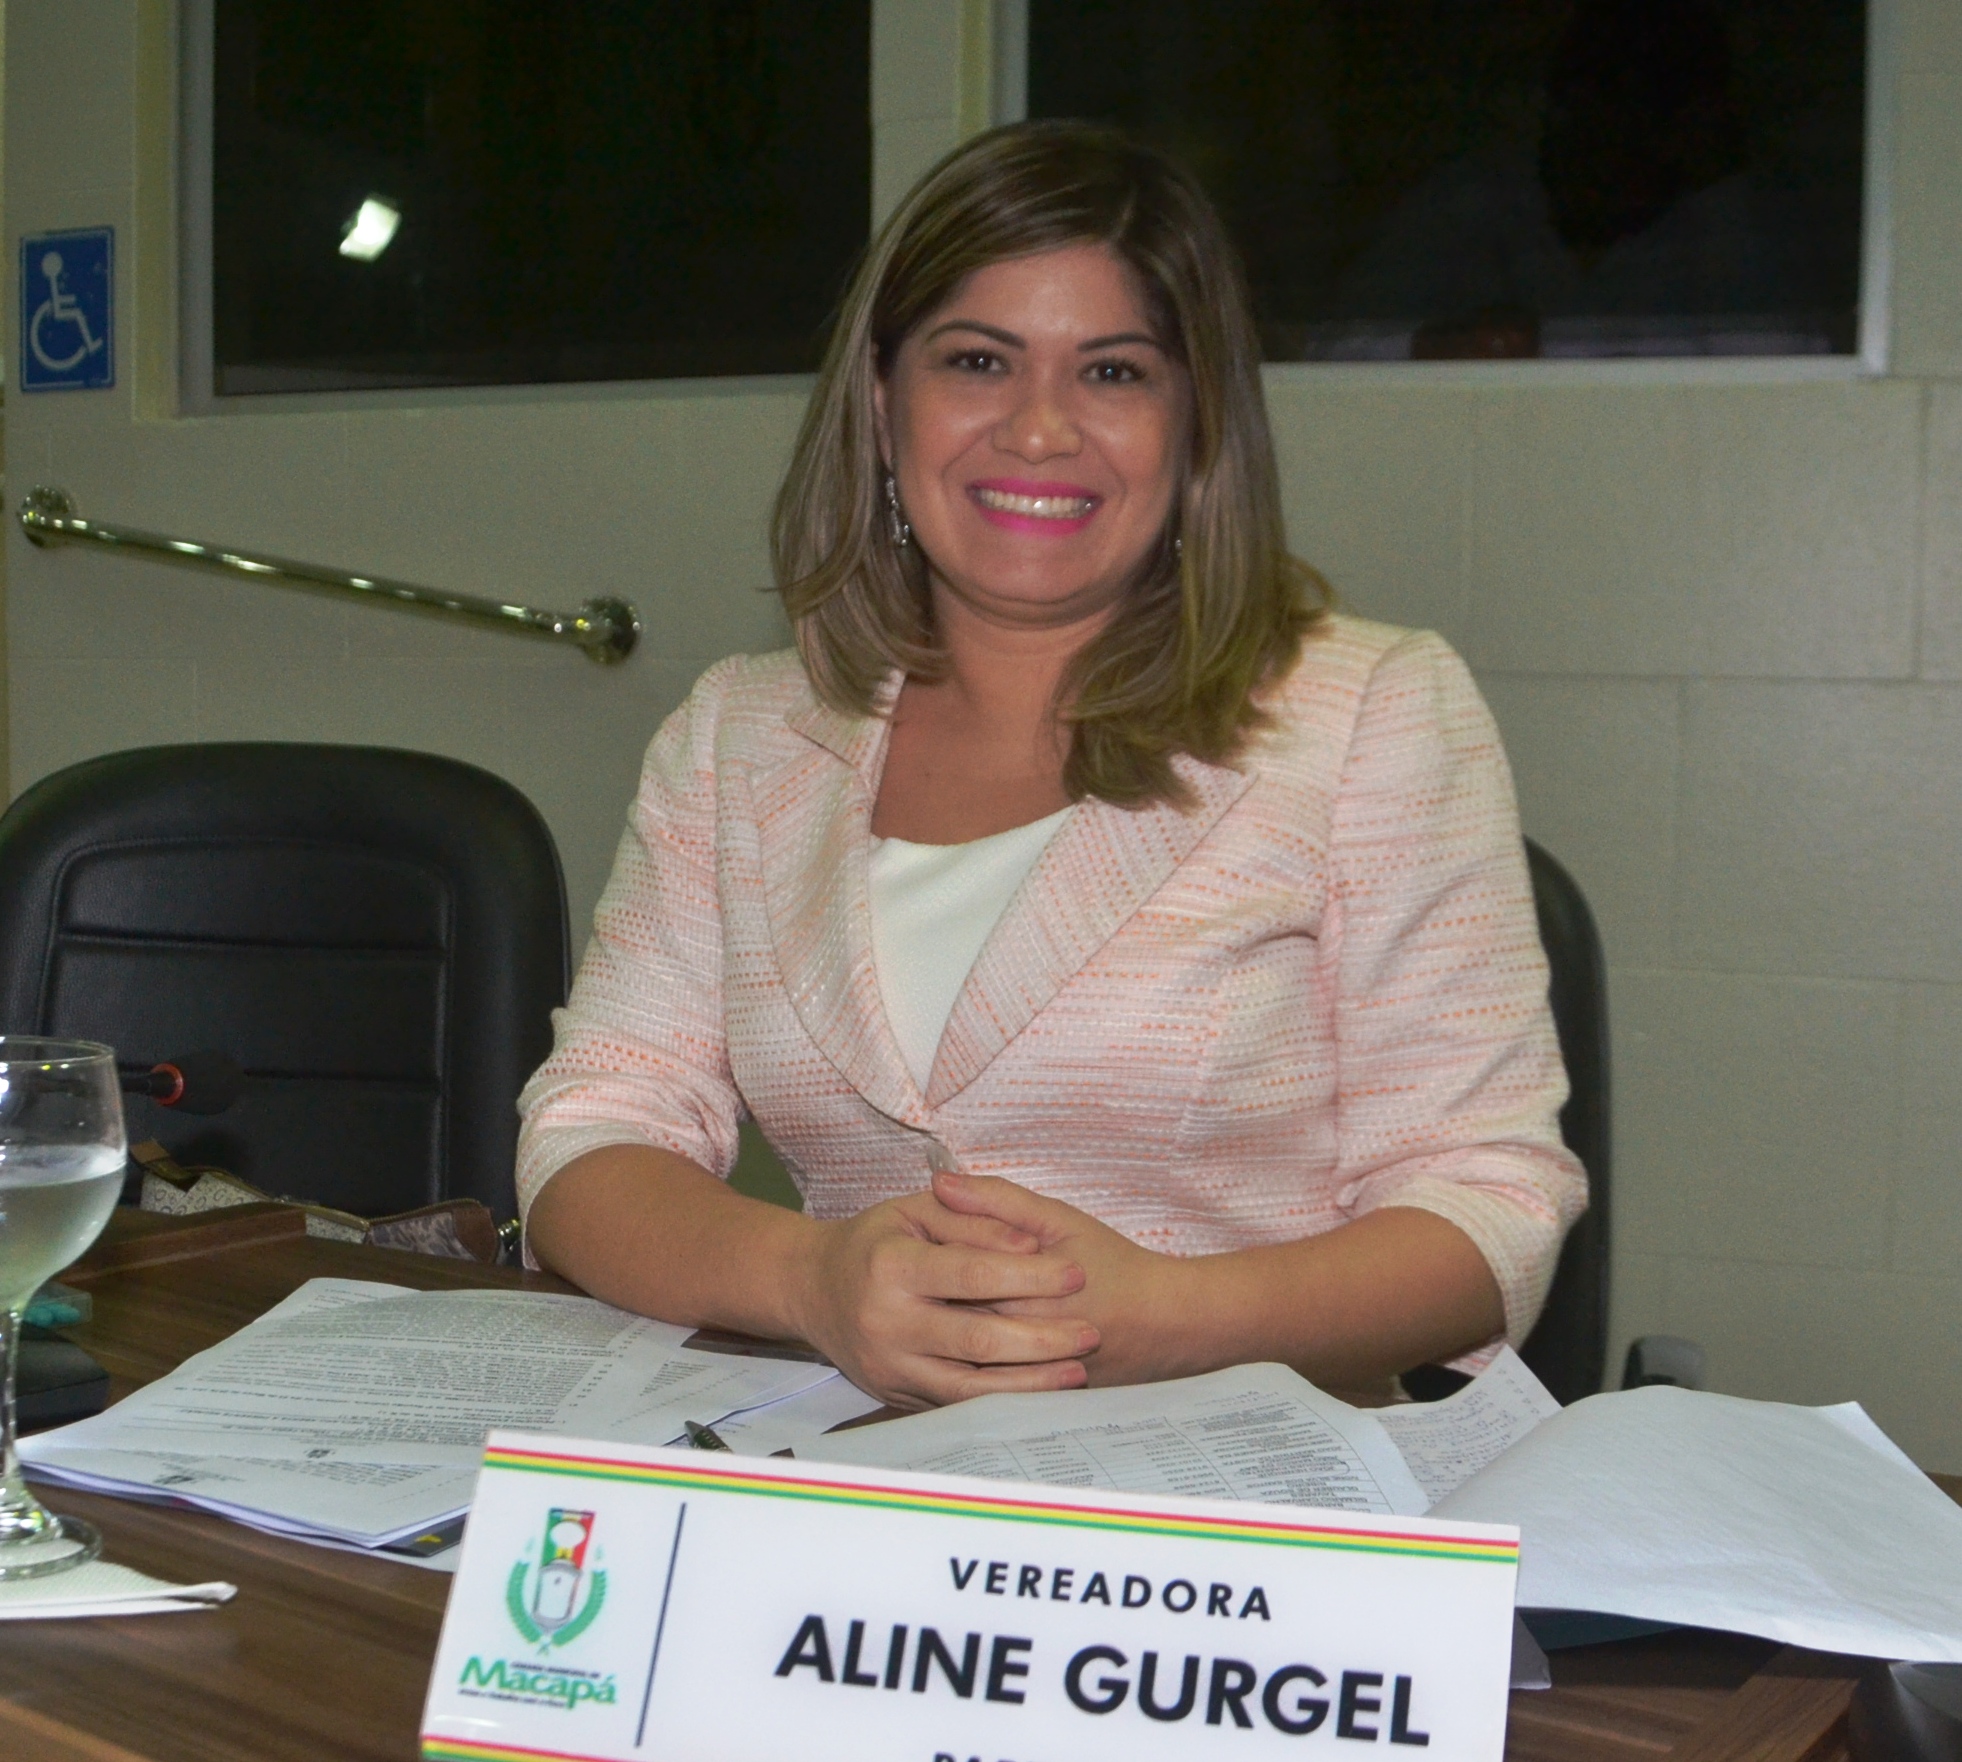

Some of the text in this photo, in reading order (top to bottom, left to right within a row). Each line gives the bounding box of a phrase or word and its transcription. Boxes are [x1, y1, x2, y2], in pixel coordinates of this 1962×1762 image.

[950, 1558, 1270, 1621] VEREADORA
[459, 1655, 617, 1709] Macapá
[775, 1615, 1429, 1747] ALINE GURGEL
